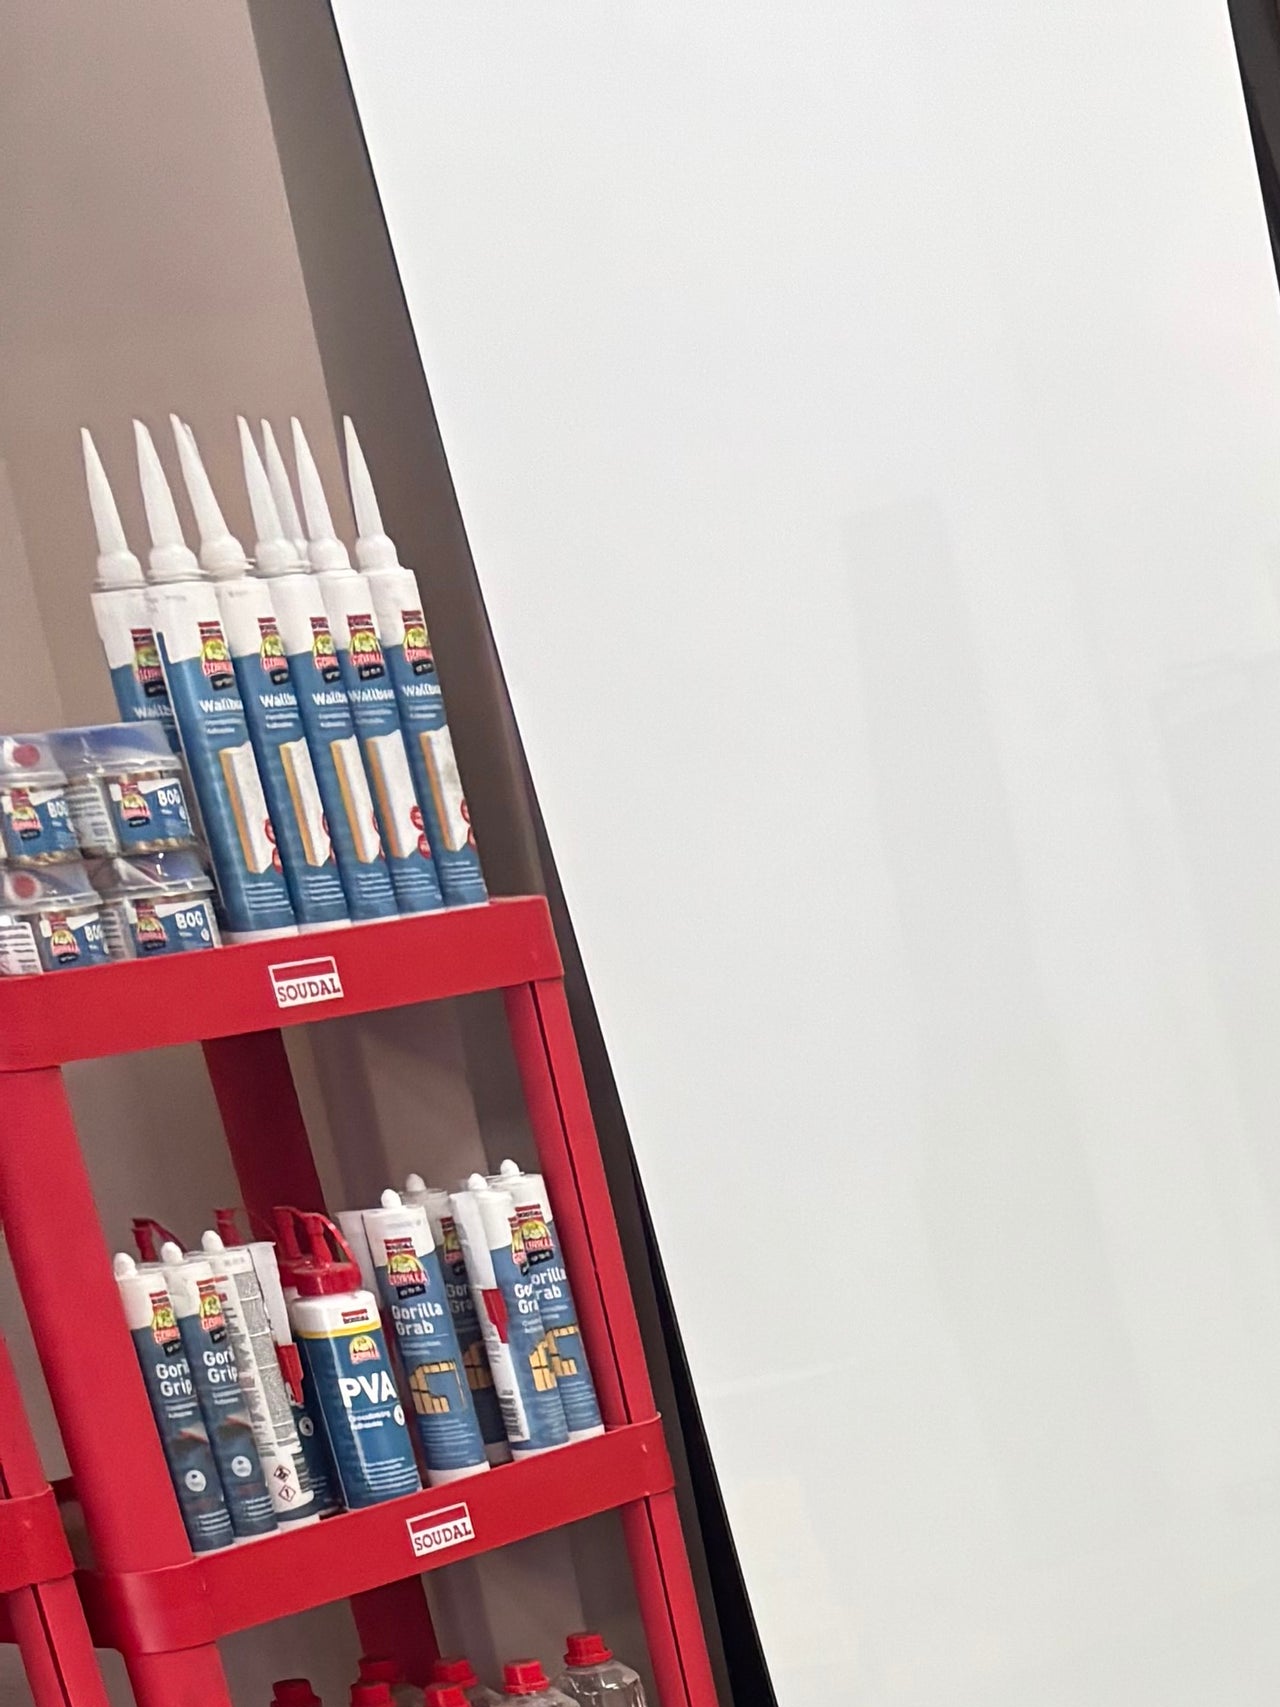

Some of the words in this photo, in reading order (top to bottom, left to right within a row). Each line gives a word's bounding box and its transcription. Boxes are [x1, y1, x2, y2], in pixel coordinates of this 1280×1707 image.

[175, 911, 204, 929] BOG
[277, 977, 341, 1003] SOUDAL
[392, 1302, 443, 1320] Gorilla
[395, 1320, 434, 1335] Grab
[207, 1367, 238, 1386] Grip
[160, 1377, 193, 1397] Grip
[338, 1371, 397, 1408] PVA
[414, 1521, 472, 1552] SOUDAL
